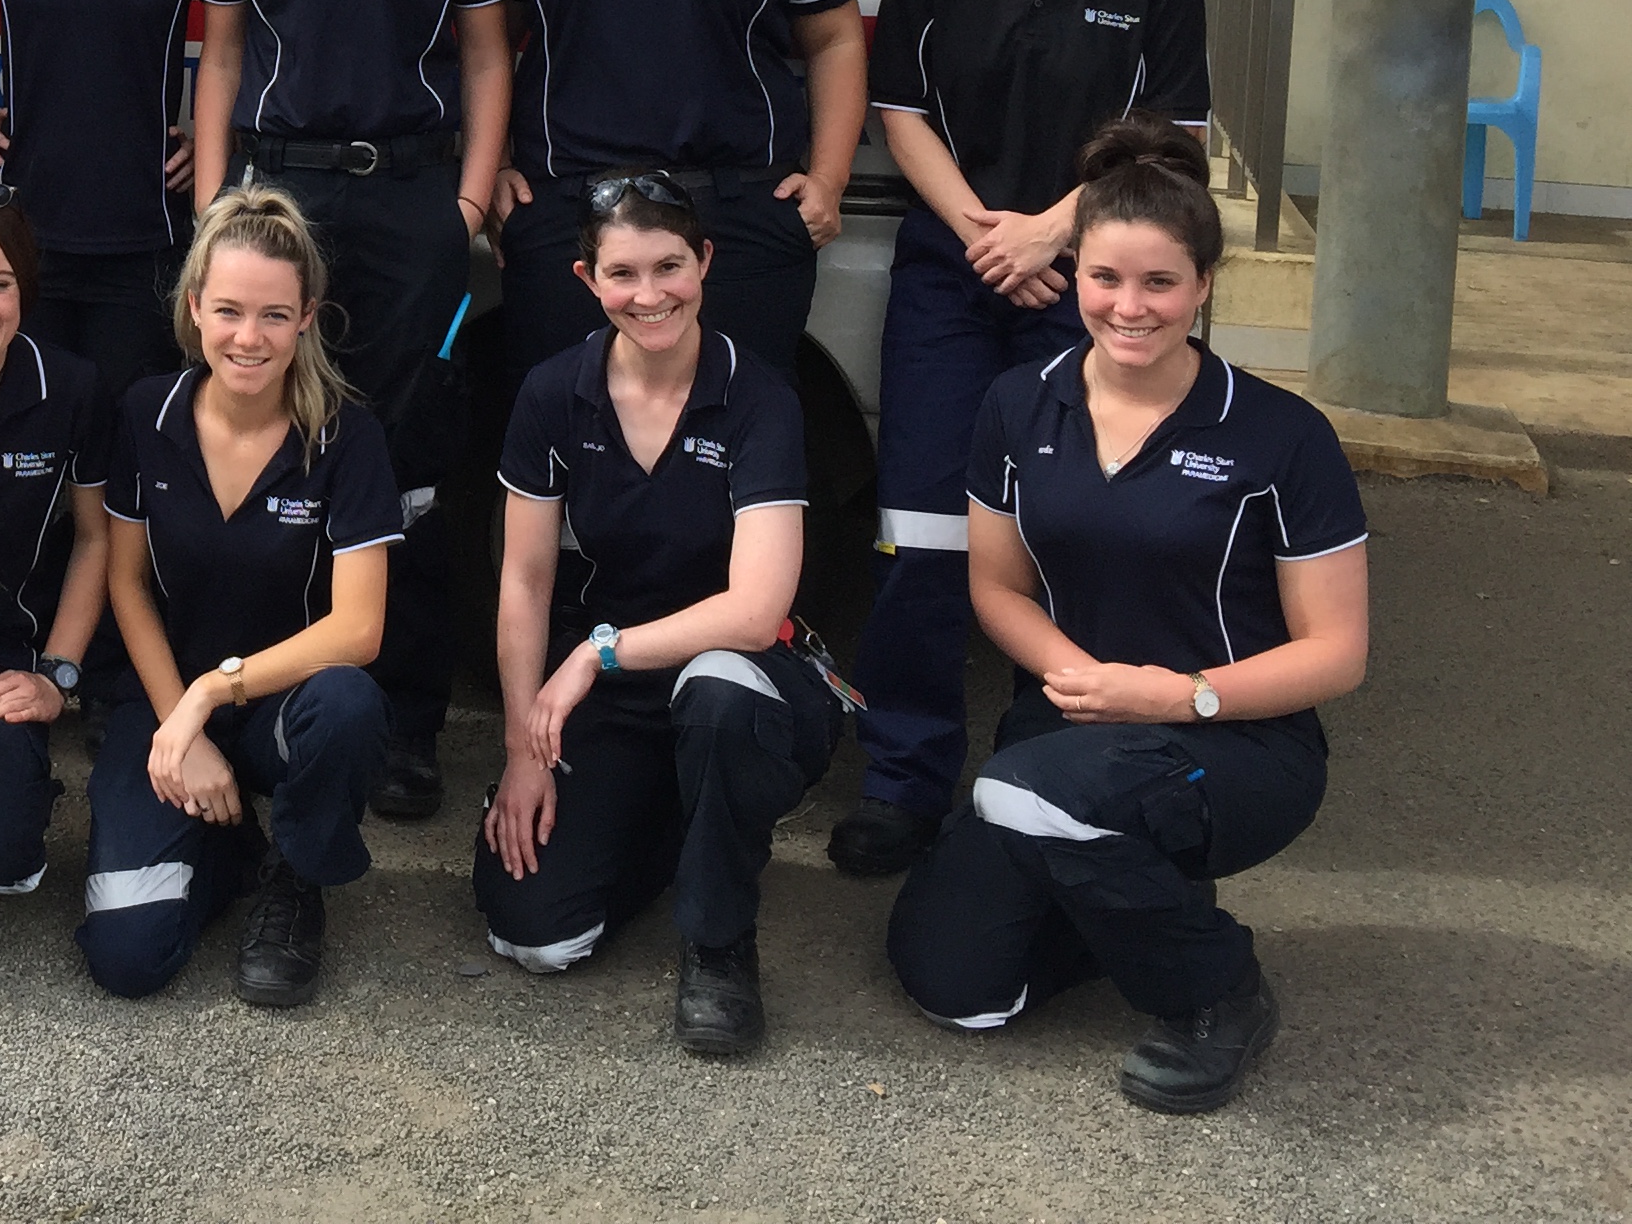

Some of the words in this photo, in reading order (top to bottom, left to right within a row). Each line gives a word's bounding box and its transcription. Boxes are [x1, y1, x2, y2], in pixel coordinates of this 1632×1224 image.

[1186, 451, 1214, 464] Charles
[1215, 456, 1235, 466] Sturt
[1185, 459, 1221, 474] University
